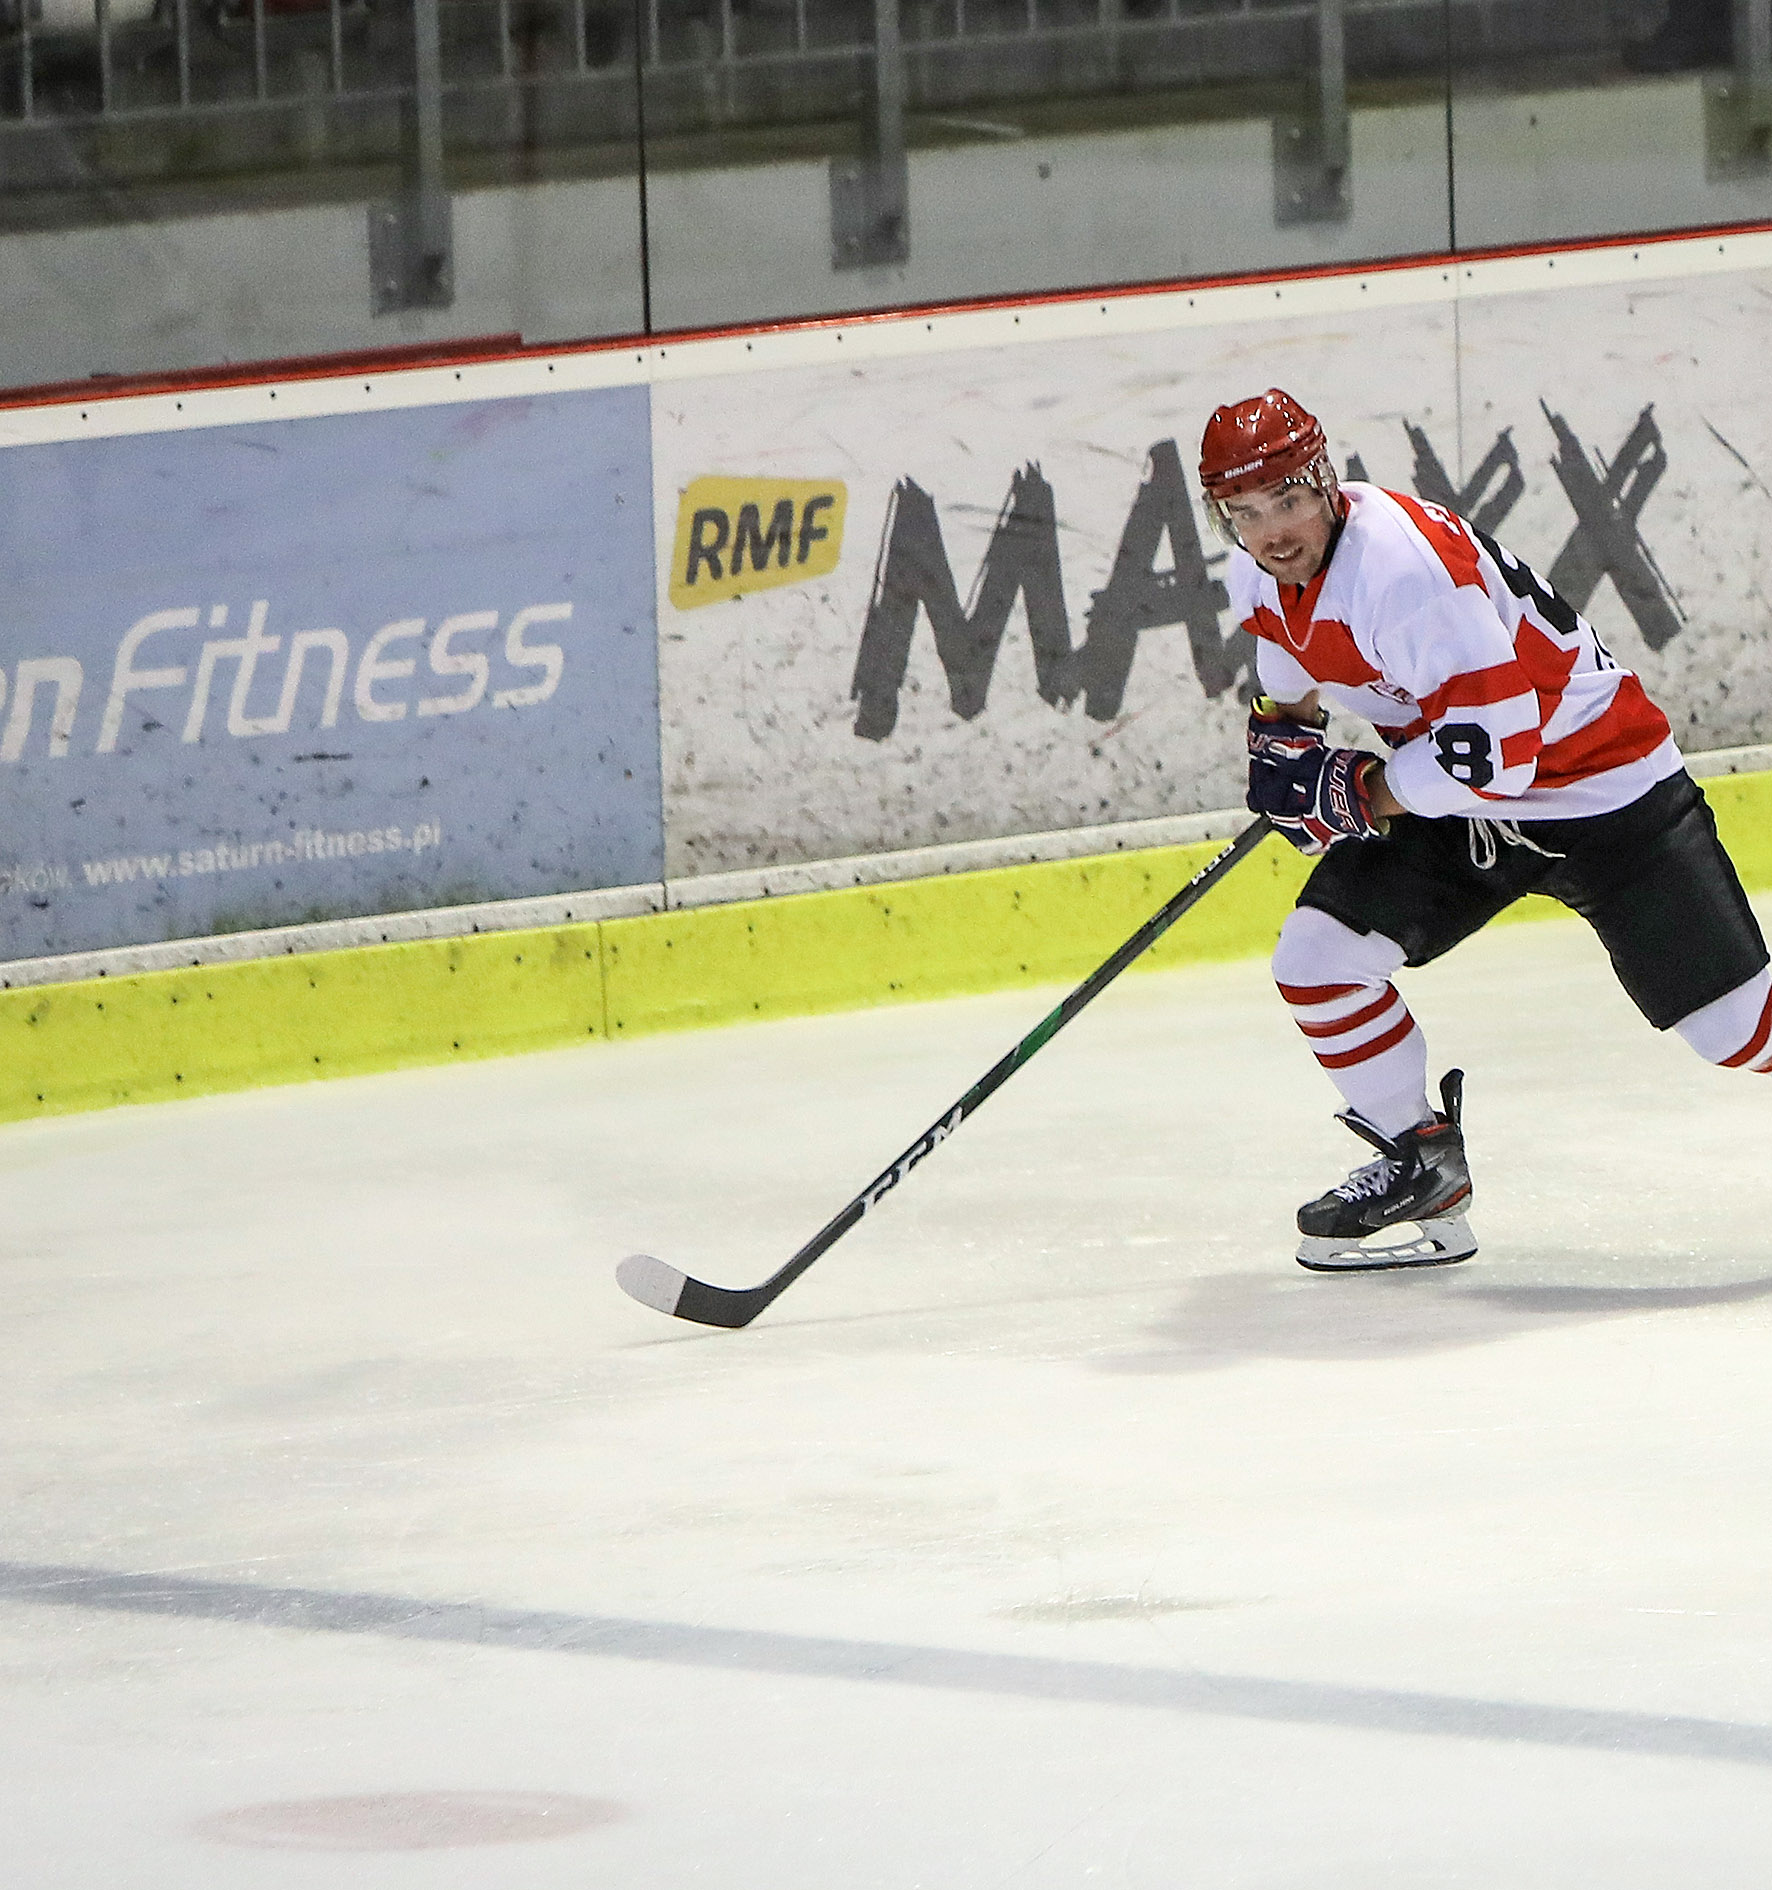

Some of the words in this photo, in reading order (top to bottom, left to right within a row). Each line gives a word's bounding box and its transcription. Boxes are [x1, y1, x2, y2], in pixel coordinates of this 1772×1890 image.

[684, 494, 835, 586] RMF
[97, 599, 573, 755] Fitness
[82, 818, 441, 886] www.saturn-fitness.pl
